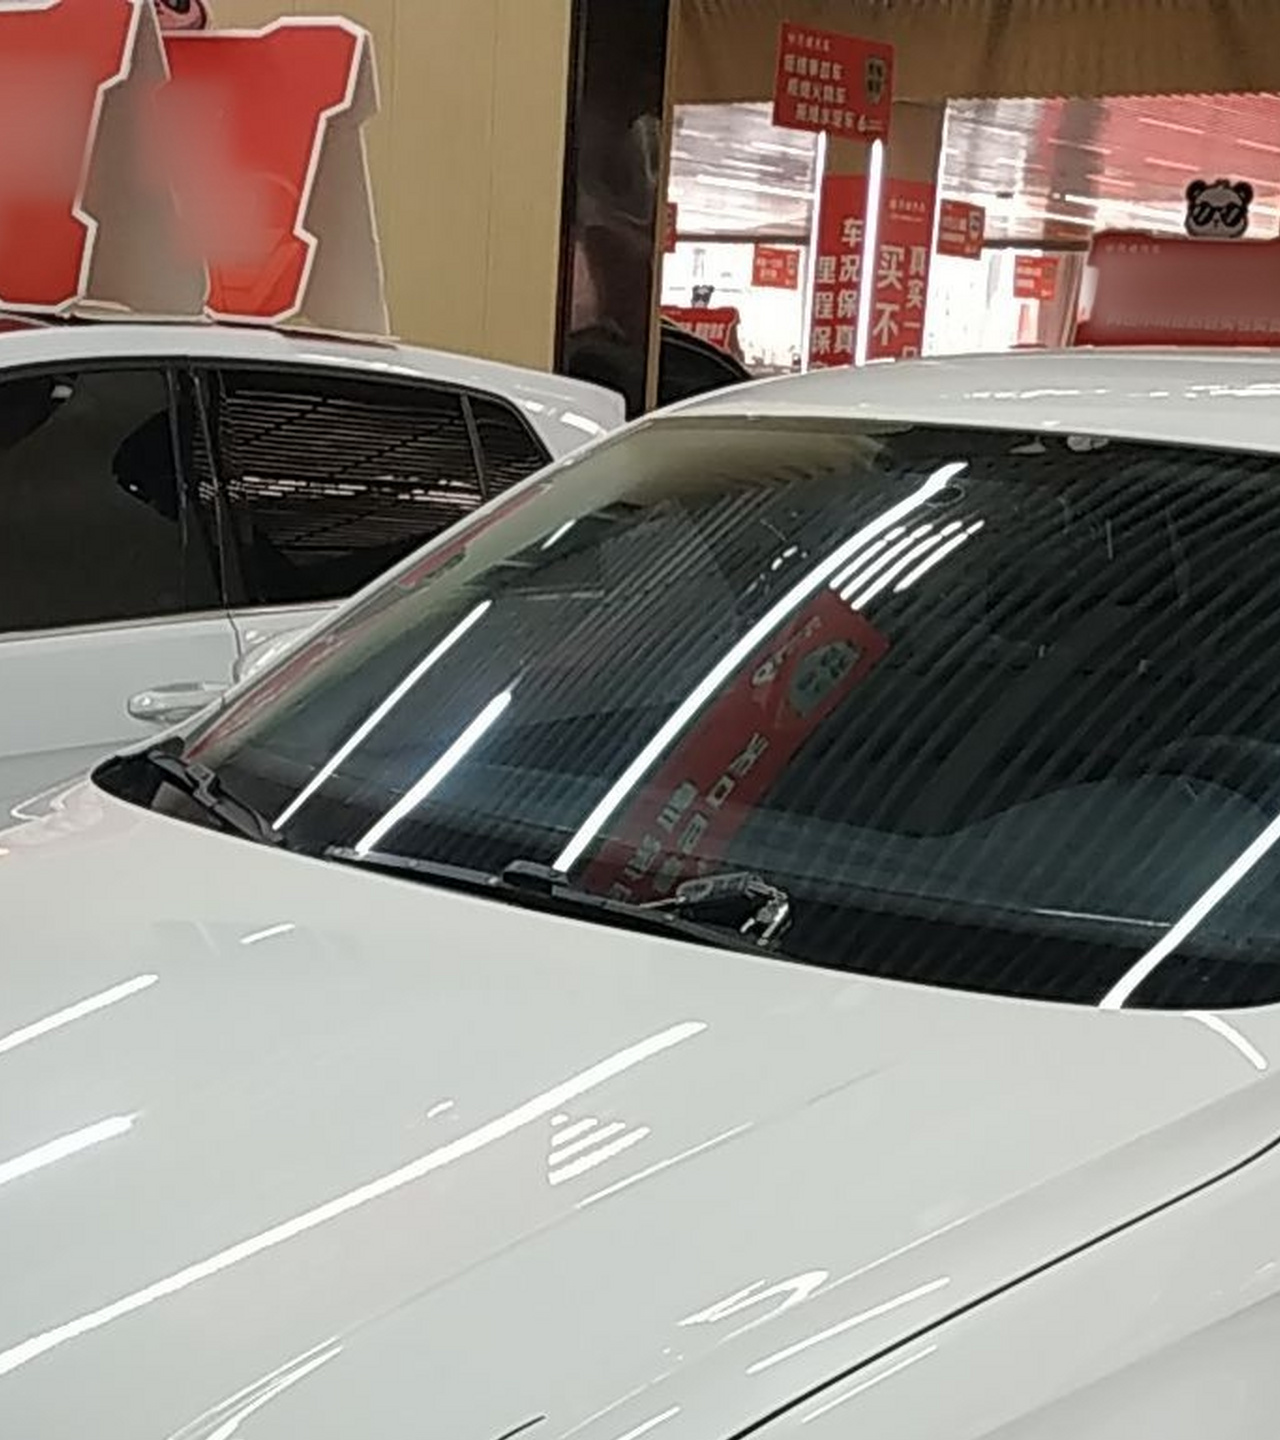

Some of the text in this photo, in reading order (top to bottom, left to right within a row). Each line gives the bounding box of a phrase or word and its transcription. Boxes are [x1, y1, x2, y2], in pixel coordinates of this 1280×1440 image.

[810, 256, 837, 369] 里程保
[833, 217, 864, 354] 车况保真
